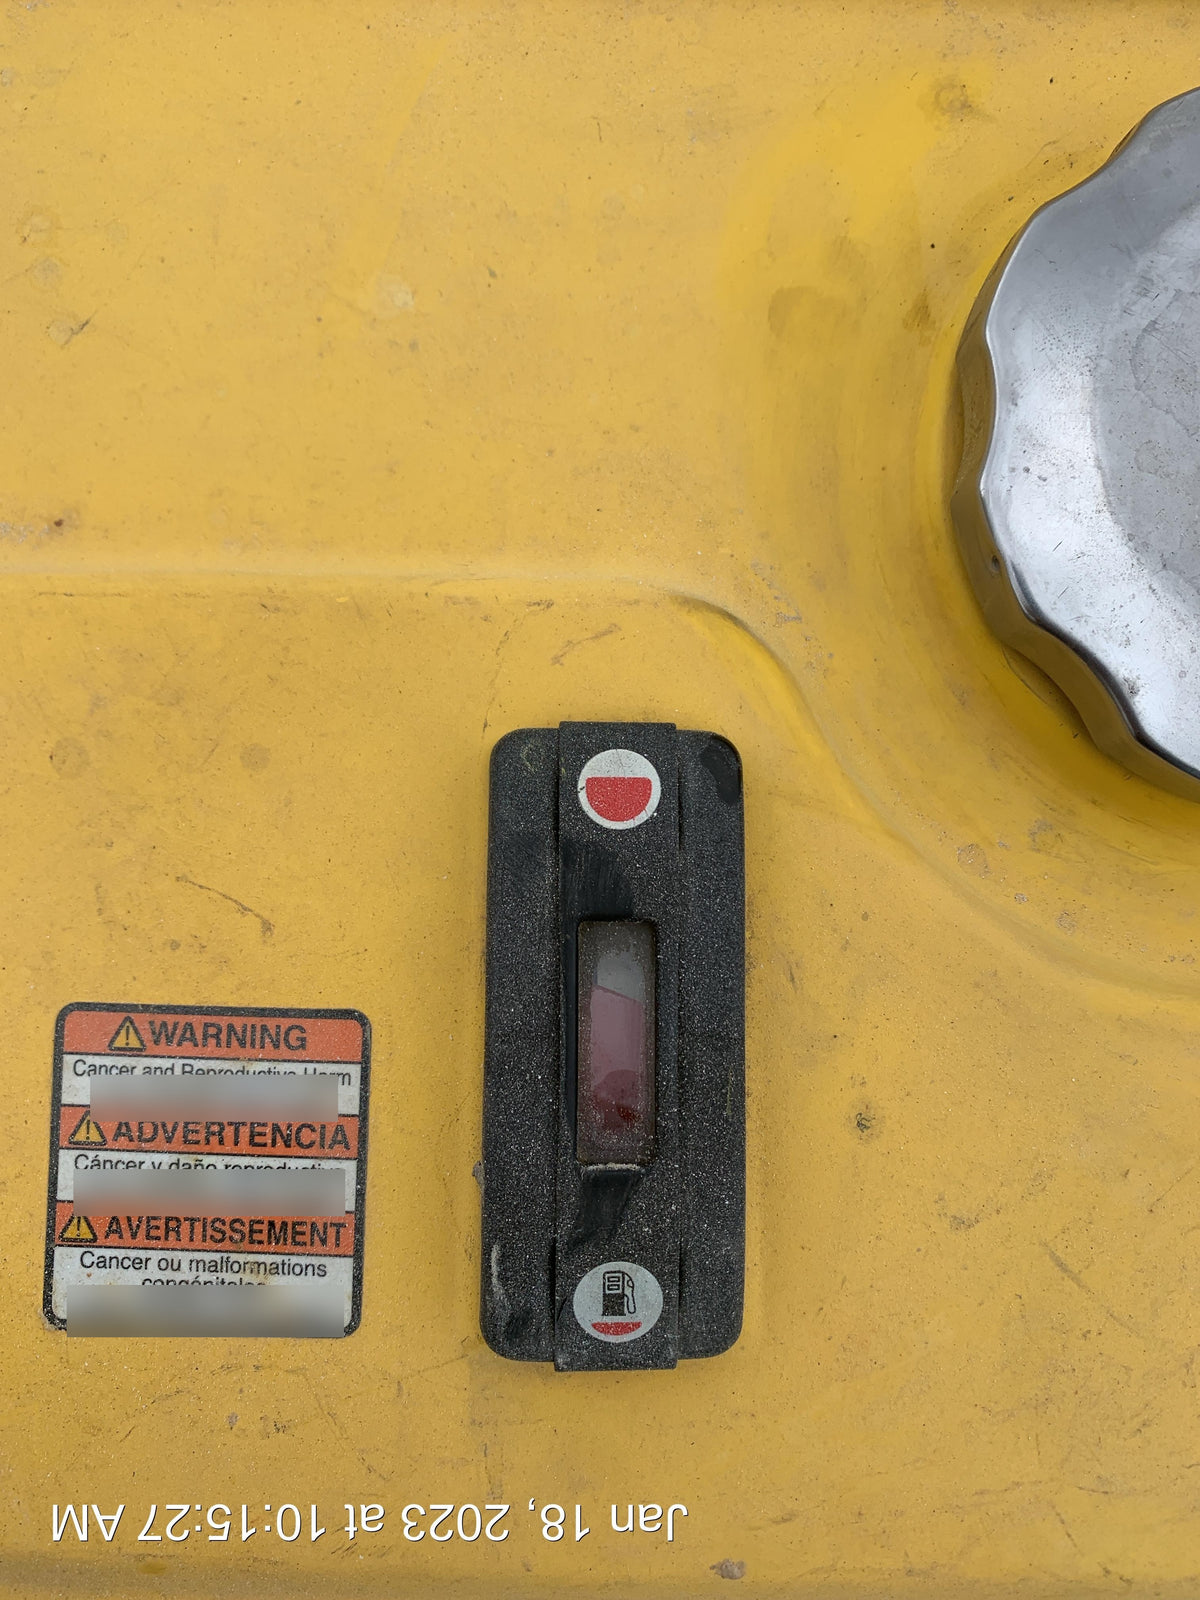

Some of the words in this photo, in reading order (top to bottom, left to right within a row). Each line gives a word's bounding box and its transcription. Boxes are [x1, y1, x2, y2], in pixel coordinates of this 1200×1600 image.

[149, 1020, 307, 1050] WARNING
[112, 1121, 351, 1149] ADVERTENCIA
[104, 1215, 346, 1248] AVERTISSEMENT
[80, 1251, 151, 1271] Cancer
[158, 1255, 181, 1271] ou
[189, 1256, 327, 1277] malformations
